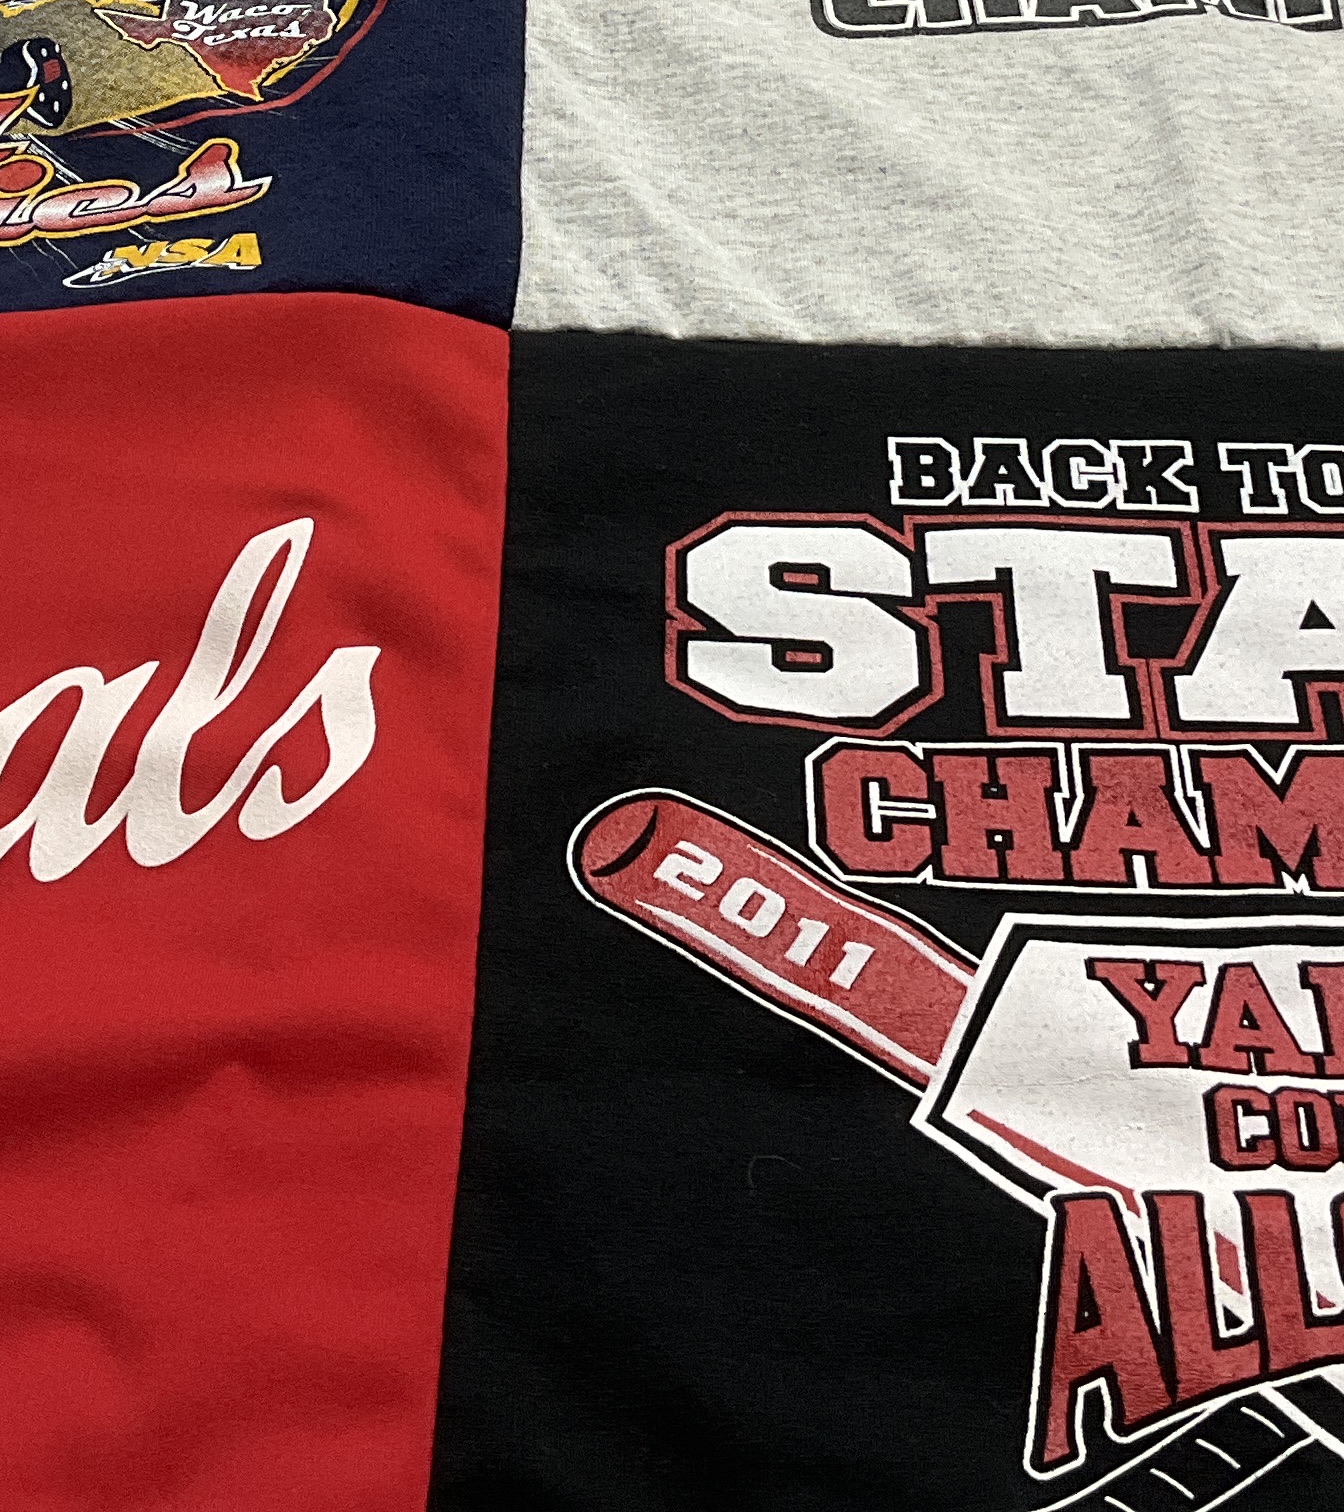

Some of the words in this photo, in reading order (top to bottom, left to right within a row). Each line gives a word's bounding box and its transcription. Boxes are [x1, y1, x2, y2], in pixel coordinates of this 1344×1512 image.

[171, 19, 308, 47] Texas
[104, 232, 263, 271] NSA
[885, 435, 1197, 510] BACK
[652, 834, 877, 992] 2011
